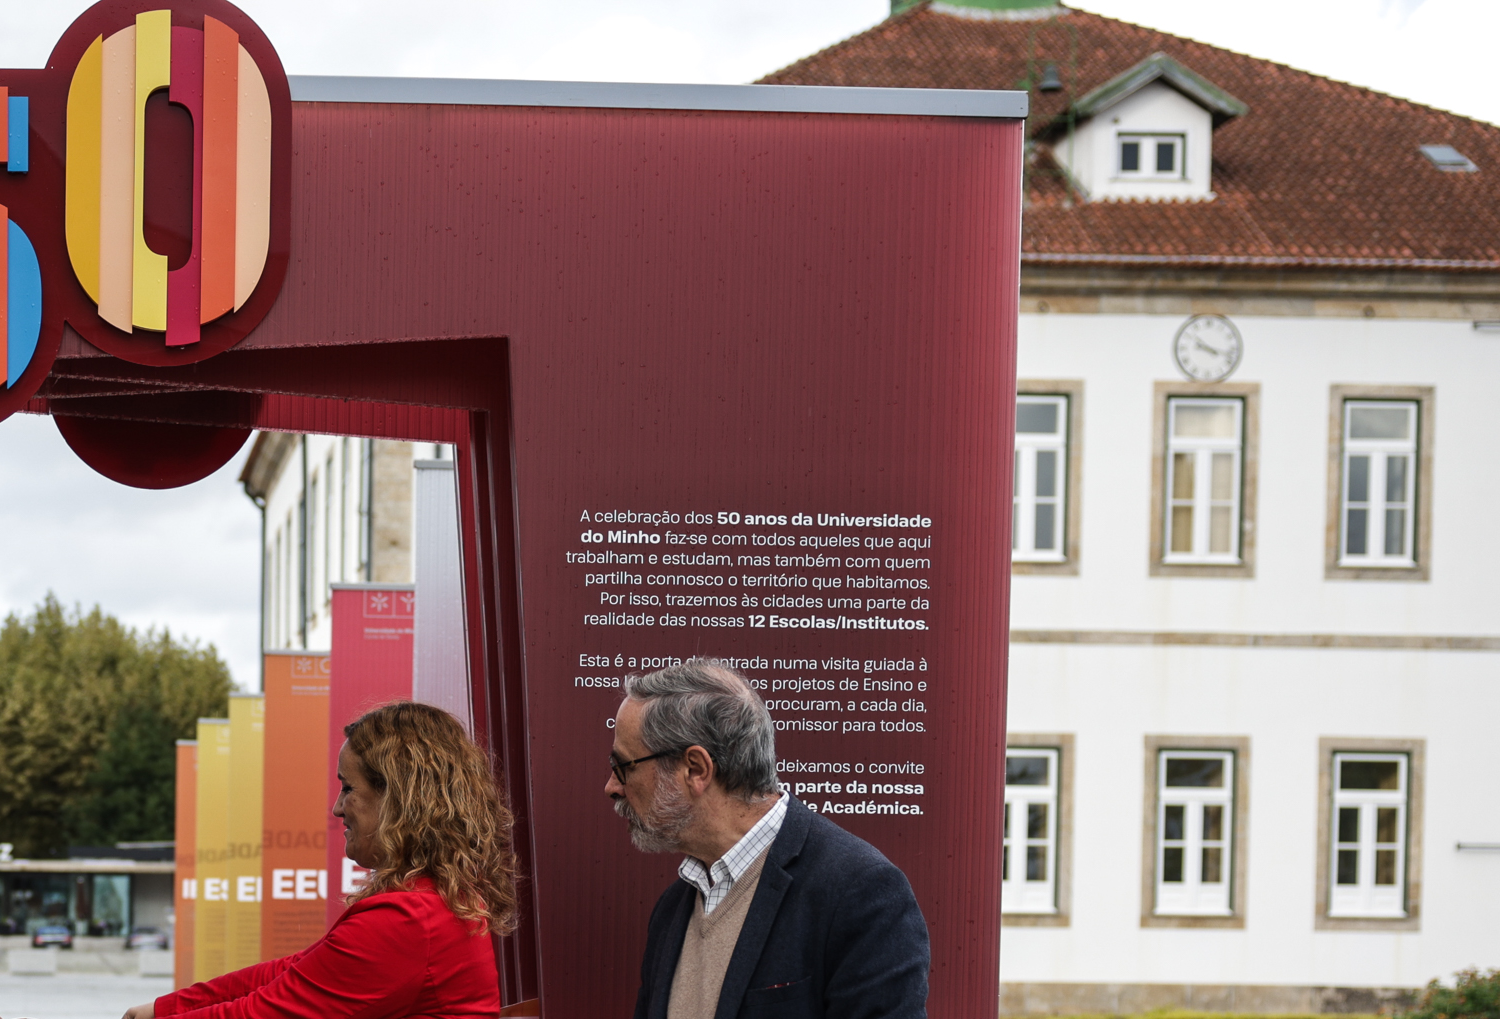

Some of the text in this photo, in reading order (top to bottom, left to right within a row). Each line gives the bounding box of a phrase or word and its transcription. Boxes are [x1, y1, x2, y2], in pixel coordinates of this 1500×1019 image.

[579, 509, 932, 528] A celebração dos 50 anos da Universidade
[580, 529, 931, 551] do Minho faz-se com todos aqueles que aqui
[565, 549, 931, 572] trabalham e estudam, mas também com quem
[585, 570, 931, 591] partilha connosco o território que habitamos.
[600, 591, 930, 612] Por isso, trazemos às cidades uma parte da
[584, 611, 930, 631] realidade das nossas 12 Escolas/Institutos.
[579, 653, 610, 668] Esta
[614, 653, 624, 668] é
[627, 656, 637, 668] a
[641, 656, 681, 671] porta
[773, 658, 818, 670] numa
[821, 656, 860, 671] visita
[863, 657, 915, 674] guiada
[918, 657, 928, 672] à
[574, 676, 620, 688] nossa
[772, 676, 835, 693] projetos
[839, 677, 859, 691] de
[863, 677, 914, 692] Ensino
[917, 680, 927, 692] e
[765, 698, 927, 715] procuram, a cada dia,
[772, 718, 927, 734] romissor para todos.
[775, 758, 925, 775] deixamos o convite
[794, 780, 842, 796] parte
[845, 780, 868, 794] da
[871, 783, 924, 795] nossa
[821, 799, 924, 815] Académica.
